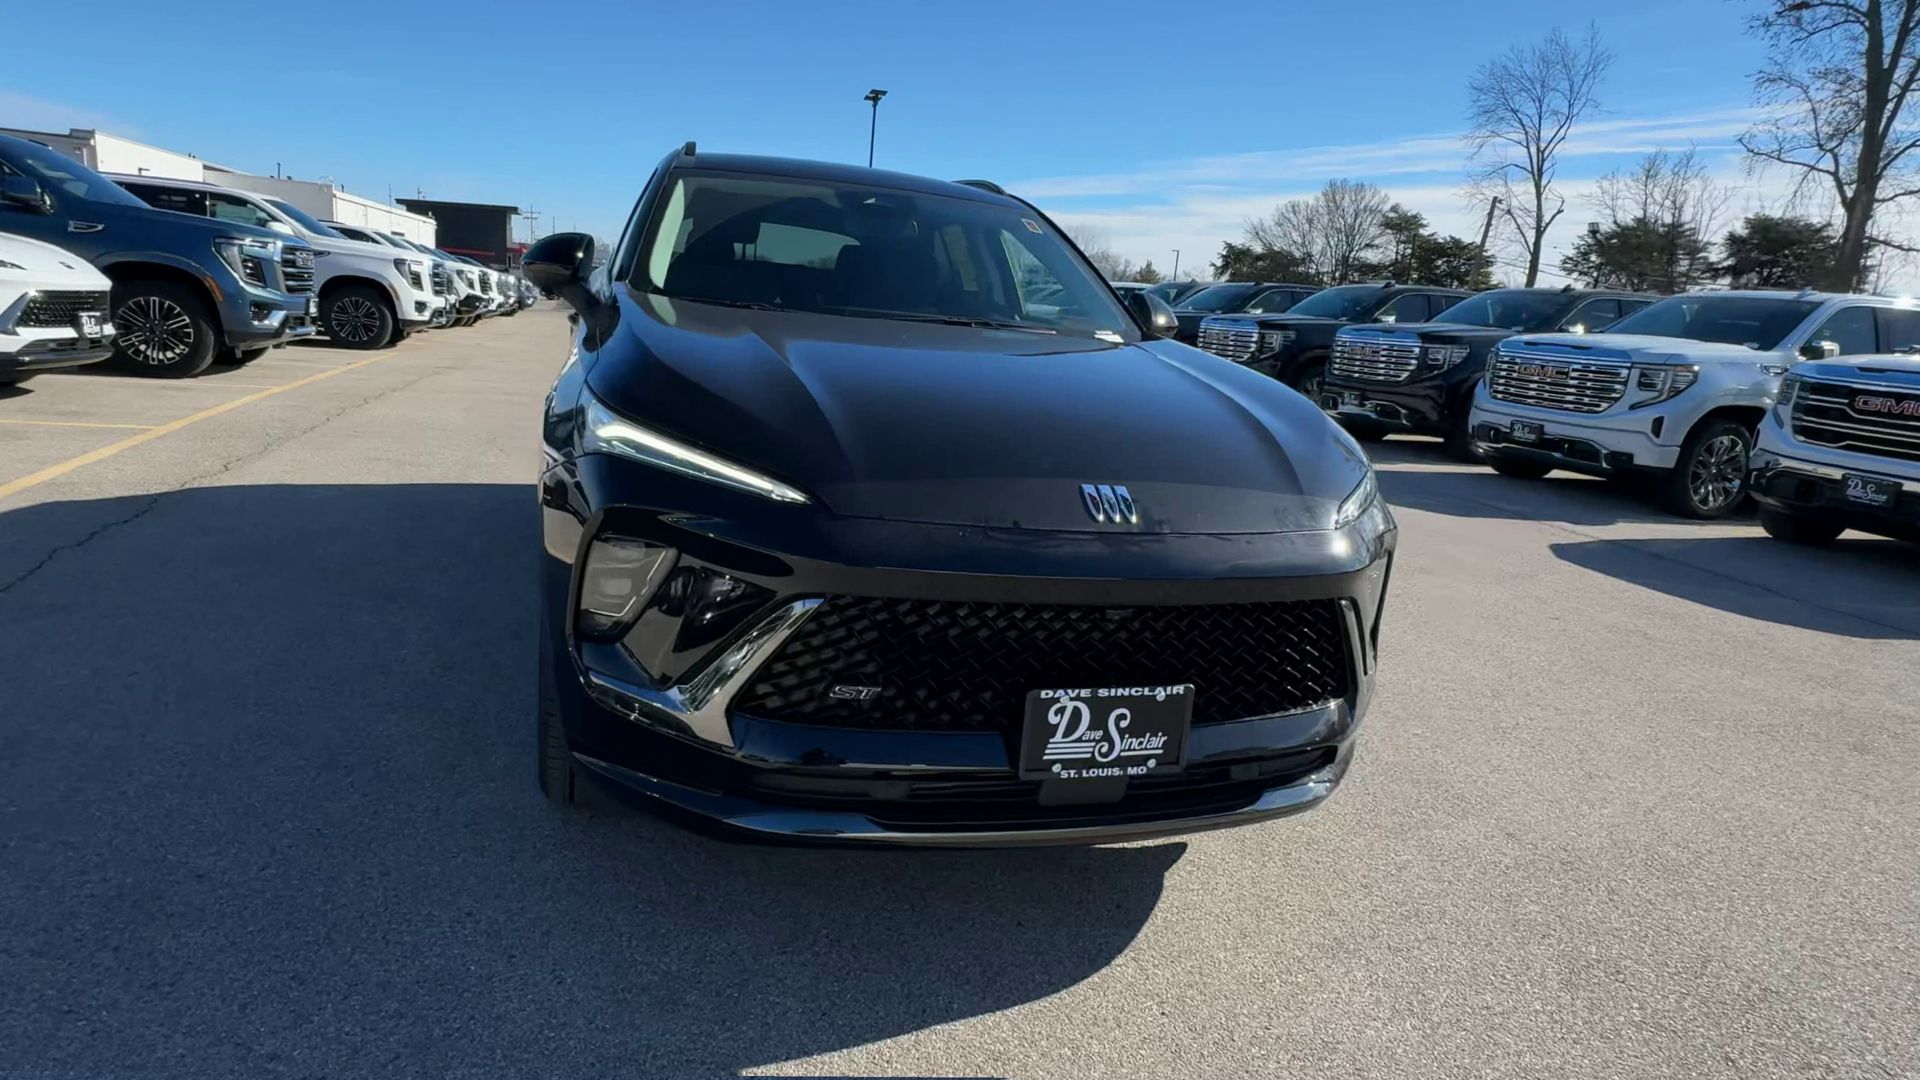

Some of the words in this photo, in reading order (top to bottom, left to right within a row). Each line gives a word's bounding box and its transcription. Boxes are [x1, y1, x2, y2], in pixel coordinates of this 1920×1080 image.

[1854, 395, 1920, 416] GM
[829, 685, 882, 699] ST
[1040, 688, 1092, 699] DAVE
[1097, 685, 1185, 698] SINCLAIR
[1047, 701, 1103, 743] Dave
[1094, 707, 1168, 762] Sinclair
[1060, 769, 1079, 779] ST.
[1127, 765, 1148, 776] MO
